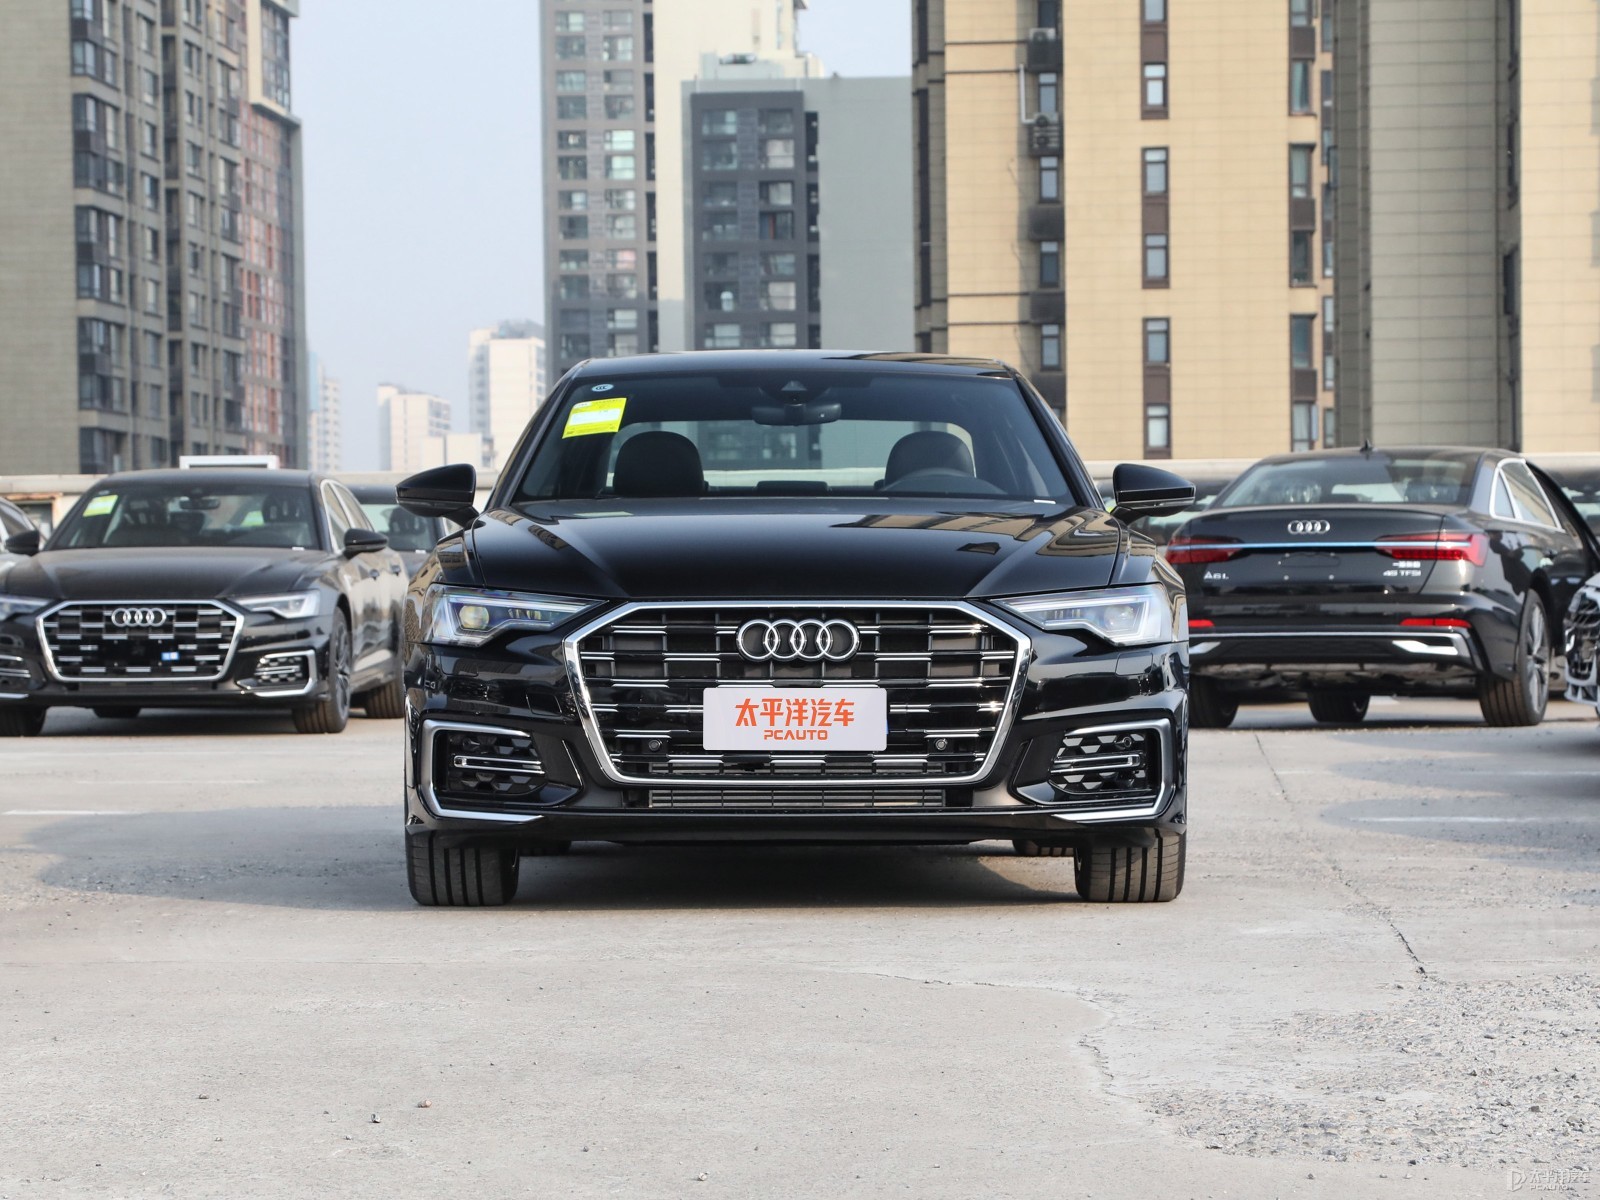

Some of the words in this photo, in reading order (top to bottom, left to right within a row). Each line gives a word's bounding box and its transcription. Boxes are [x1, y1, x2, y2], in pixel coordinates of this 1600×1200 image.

[735, 698, 855, 727] 太平洋汽车
[763, 729, 828, 741] PCAUTO
